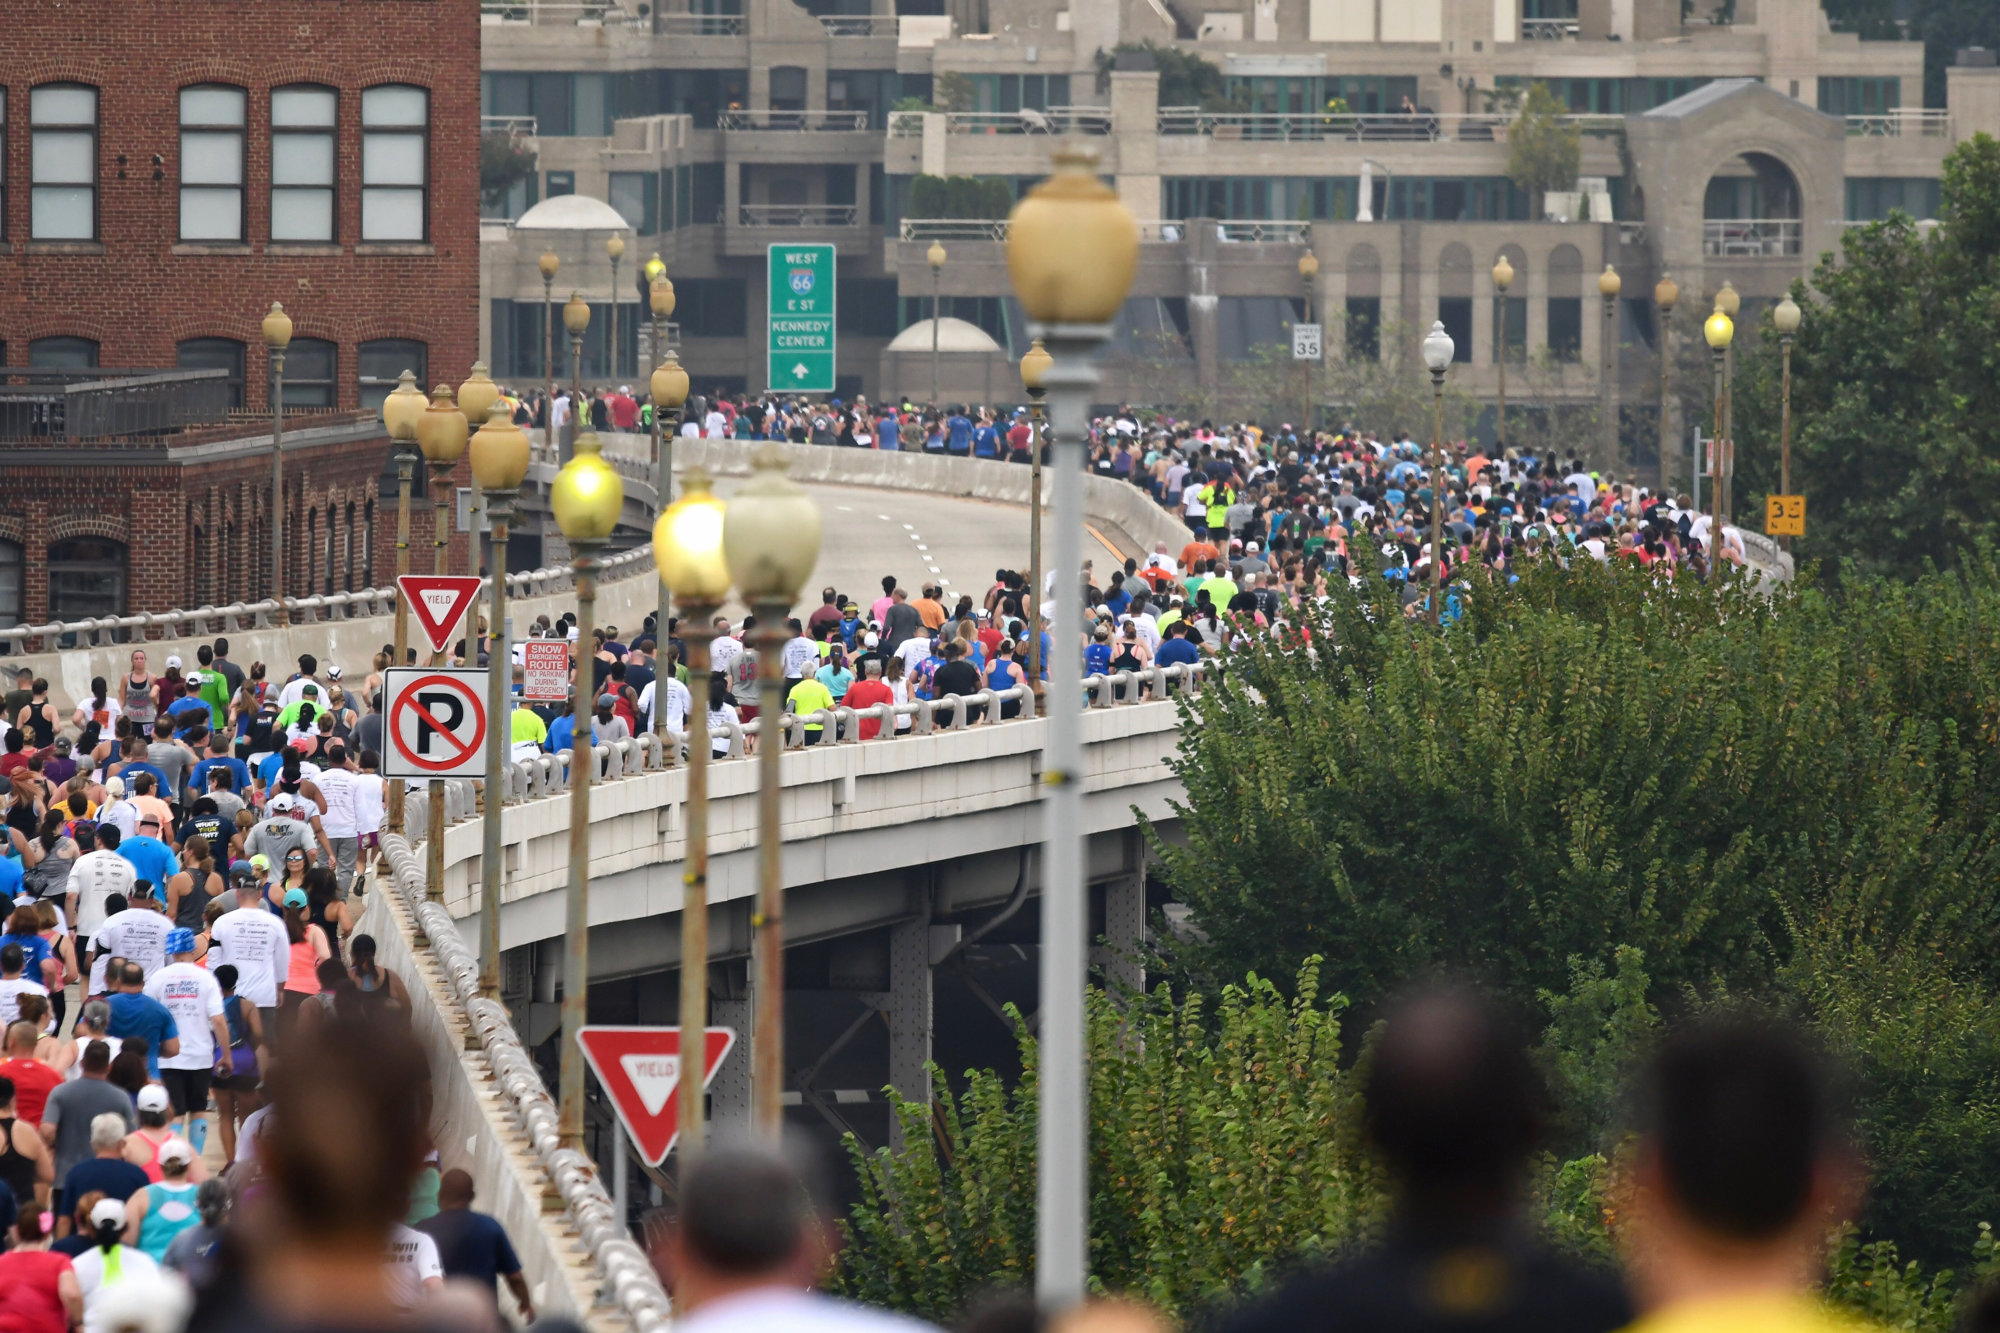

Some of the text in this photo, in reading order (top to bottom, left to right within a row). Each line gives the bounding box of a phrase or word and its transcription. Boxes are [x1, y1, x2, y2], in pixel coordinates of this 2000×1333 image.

[785, 253, 818, 264] WEST
[793, 276, 811, 290] 66
[772, 321, 831, 332] KENNEDY
[777, 336, 825, 347] CENTER
[1297, 342, 1318, 355] 35
[427, 595, 451, 605] YIELD
[531, 645, 563, 654] SNOW
[530, 661, 564, 670] ROUTE
[740, 663, 758, 681] 13
[527, 686, 565, 694] EMERGENCY
[195, 820, 221, 828] WHAT'S
[636, 1062, 675, 1077] YIELD
